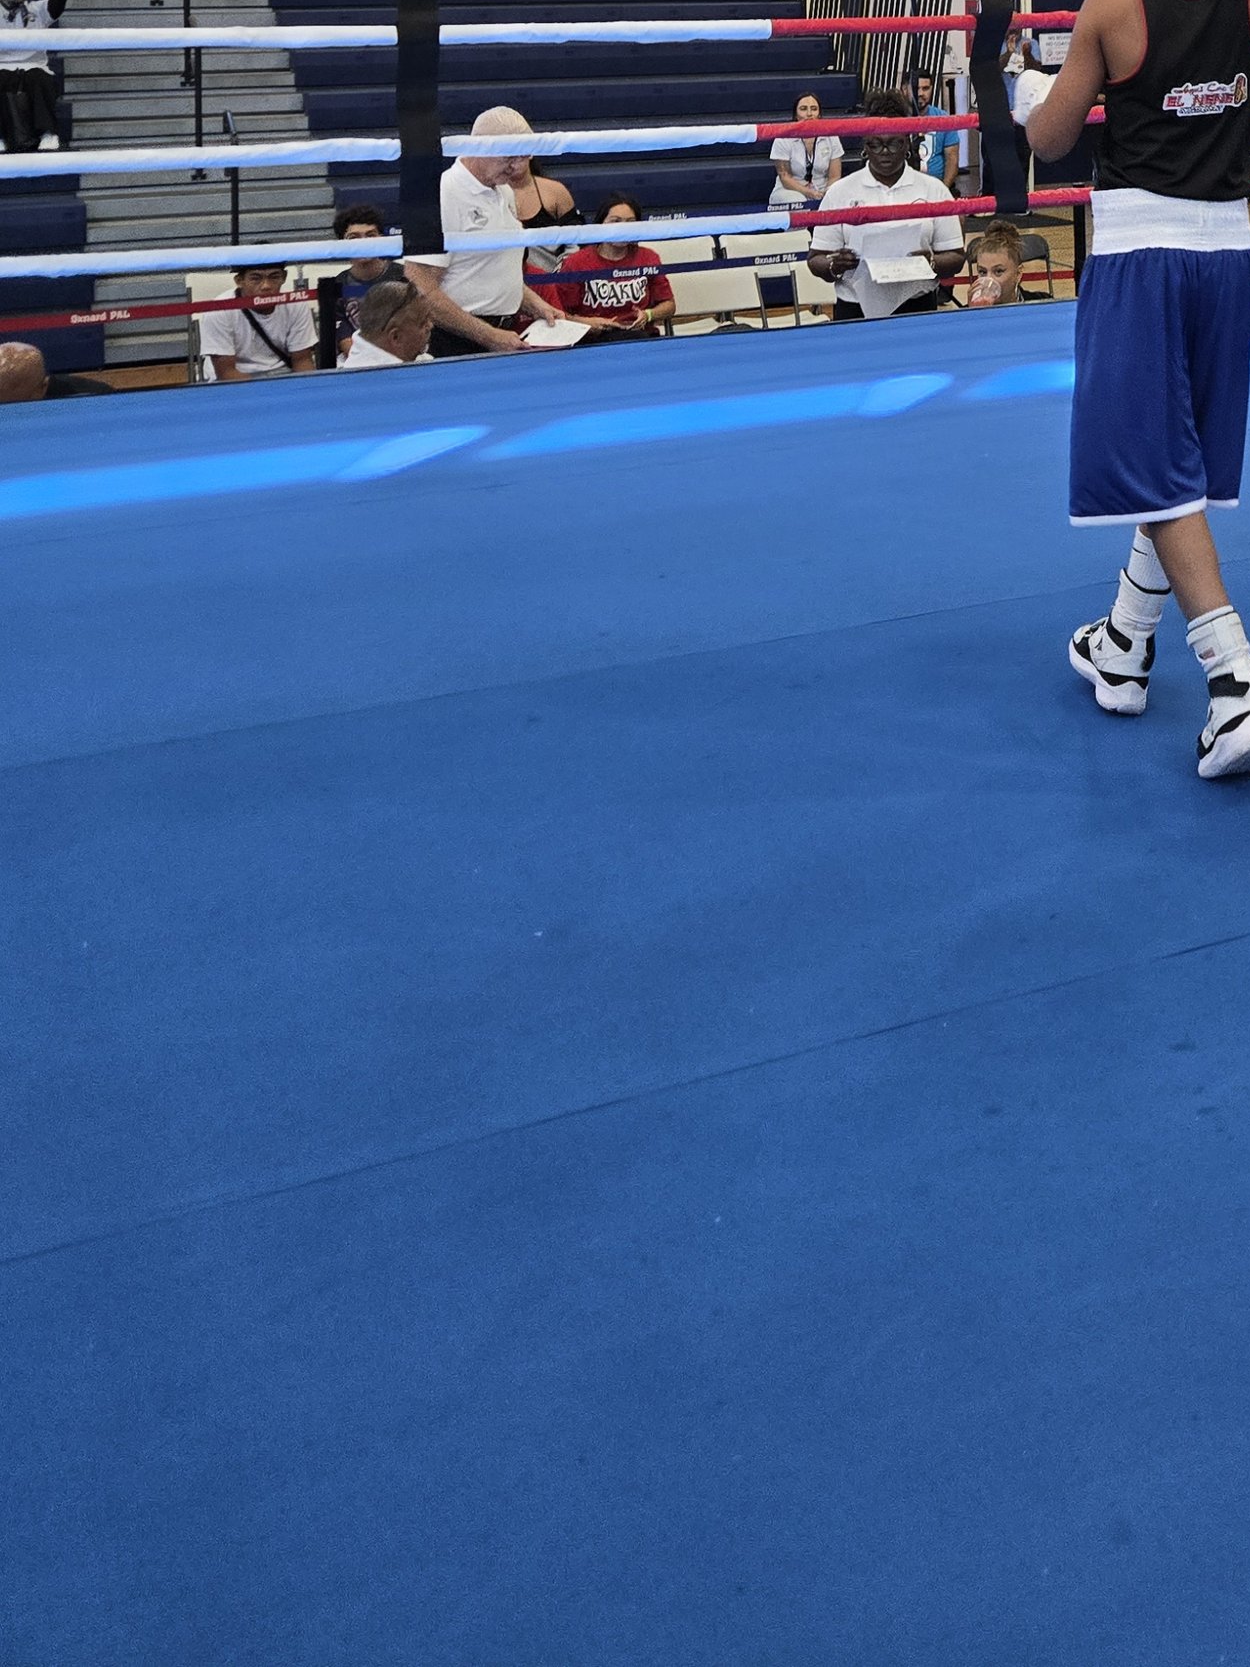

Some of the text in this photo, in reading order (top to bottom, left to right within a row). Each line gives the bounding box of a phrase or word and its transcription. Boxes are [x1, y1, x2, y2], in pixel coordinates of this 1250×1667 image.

[1166, 93, 1235, 107] EL NENE
[754, 253, 797, 265] Oxnard PAL
[612, 266, 659, 278] Oxnard PAL
[253, 291, 309, 305] Oxnard PAL
[70, 310, 131, 324] Oxnard PAL
